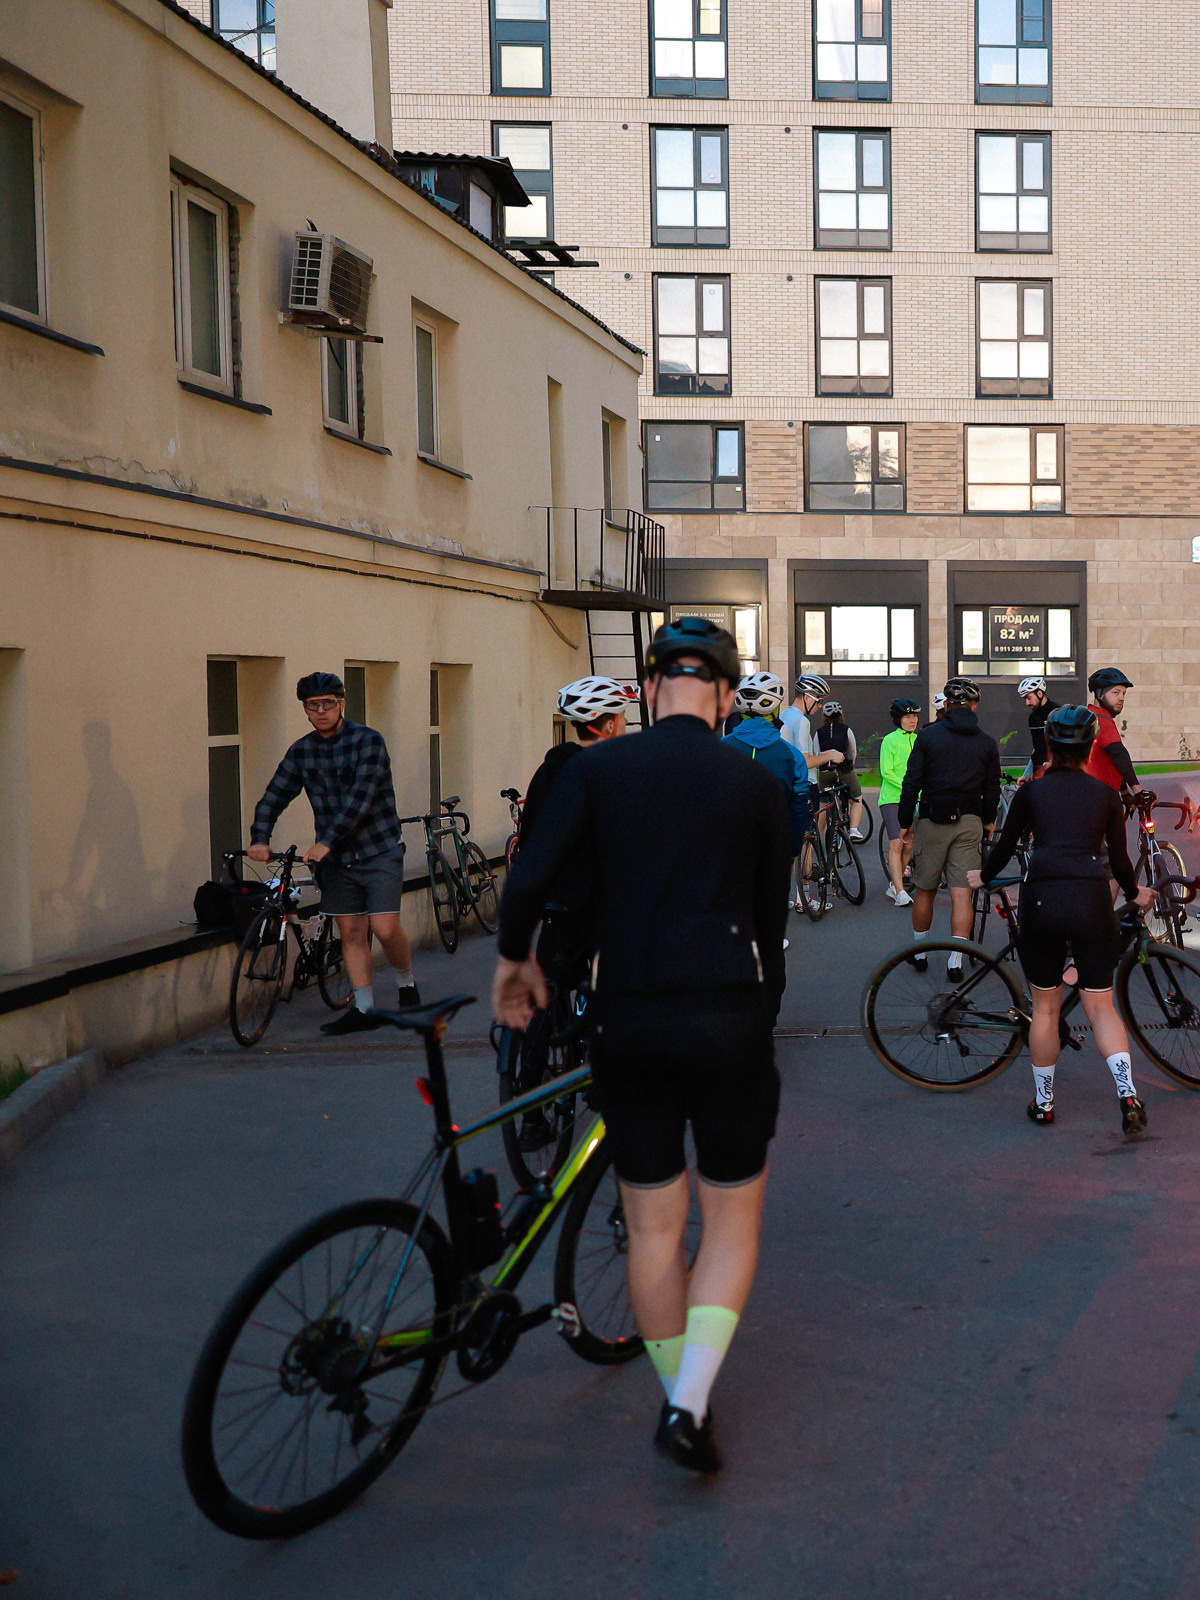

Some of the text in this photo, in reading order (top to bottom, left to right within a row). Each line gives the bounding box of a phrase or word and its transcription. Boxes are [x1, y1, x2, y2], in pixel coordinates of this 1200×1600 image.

[994, 615, 1040, 625] ПРОДАМ
[999, 629, 1016, 640] 82
[1037, 1073, 1053, 1101] Good
